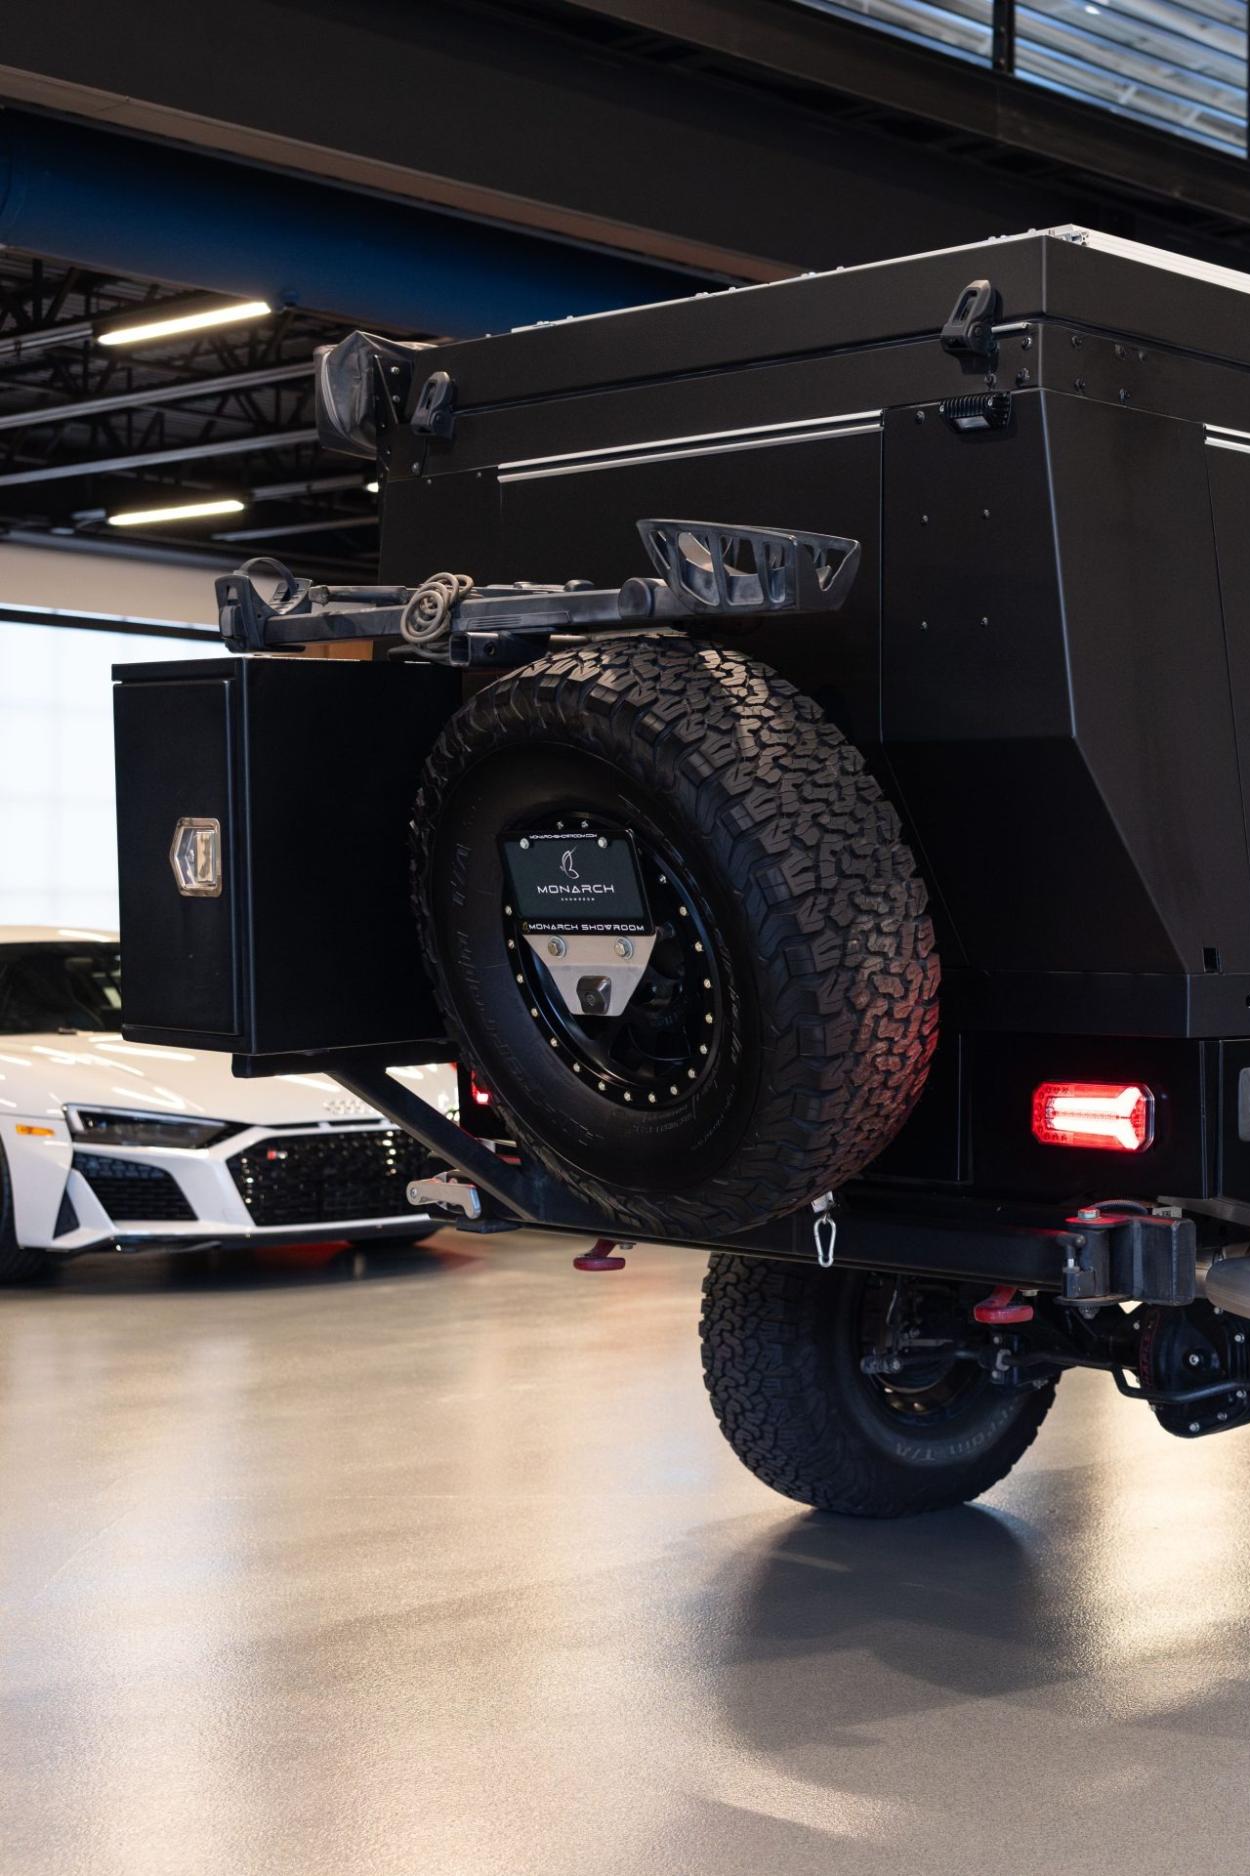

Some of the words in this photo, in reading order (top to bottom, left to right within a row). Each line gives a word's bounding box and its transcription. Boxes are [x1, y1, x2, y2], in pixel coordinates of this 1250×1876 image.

[536, 883, 615, 894] MONARCH
[528, 923, 579, 932] MONARCH
[581, 924, 645, 932] SHOWROOM
